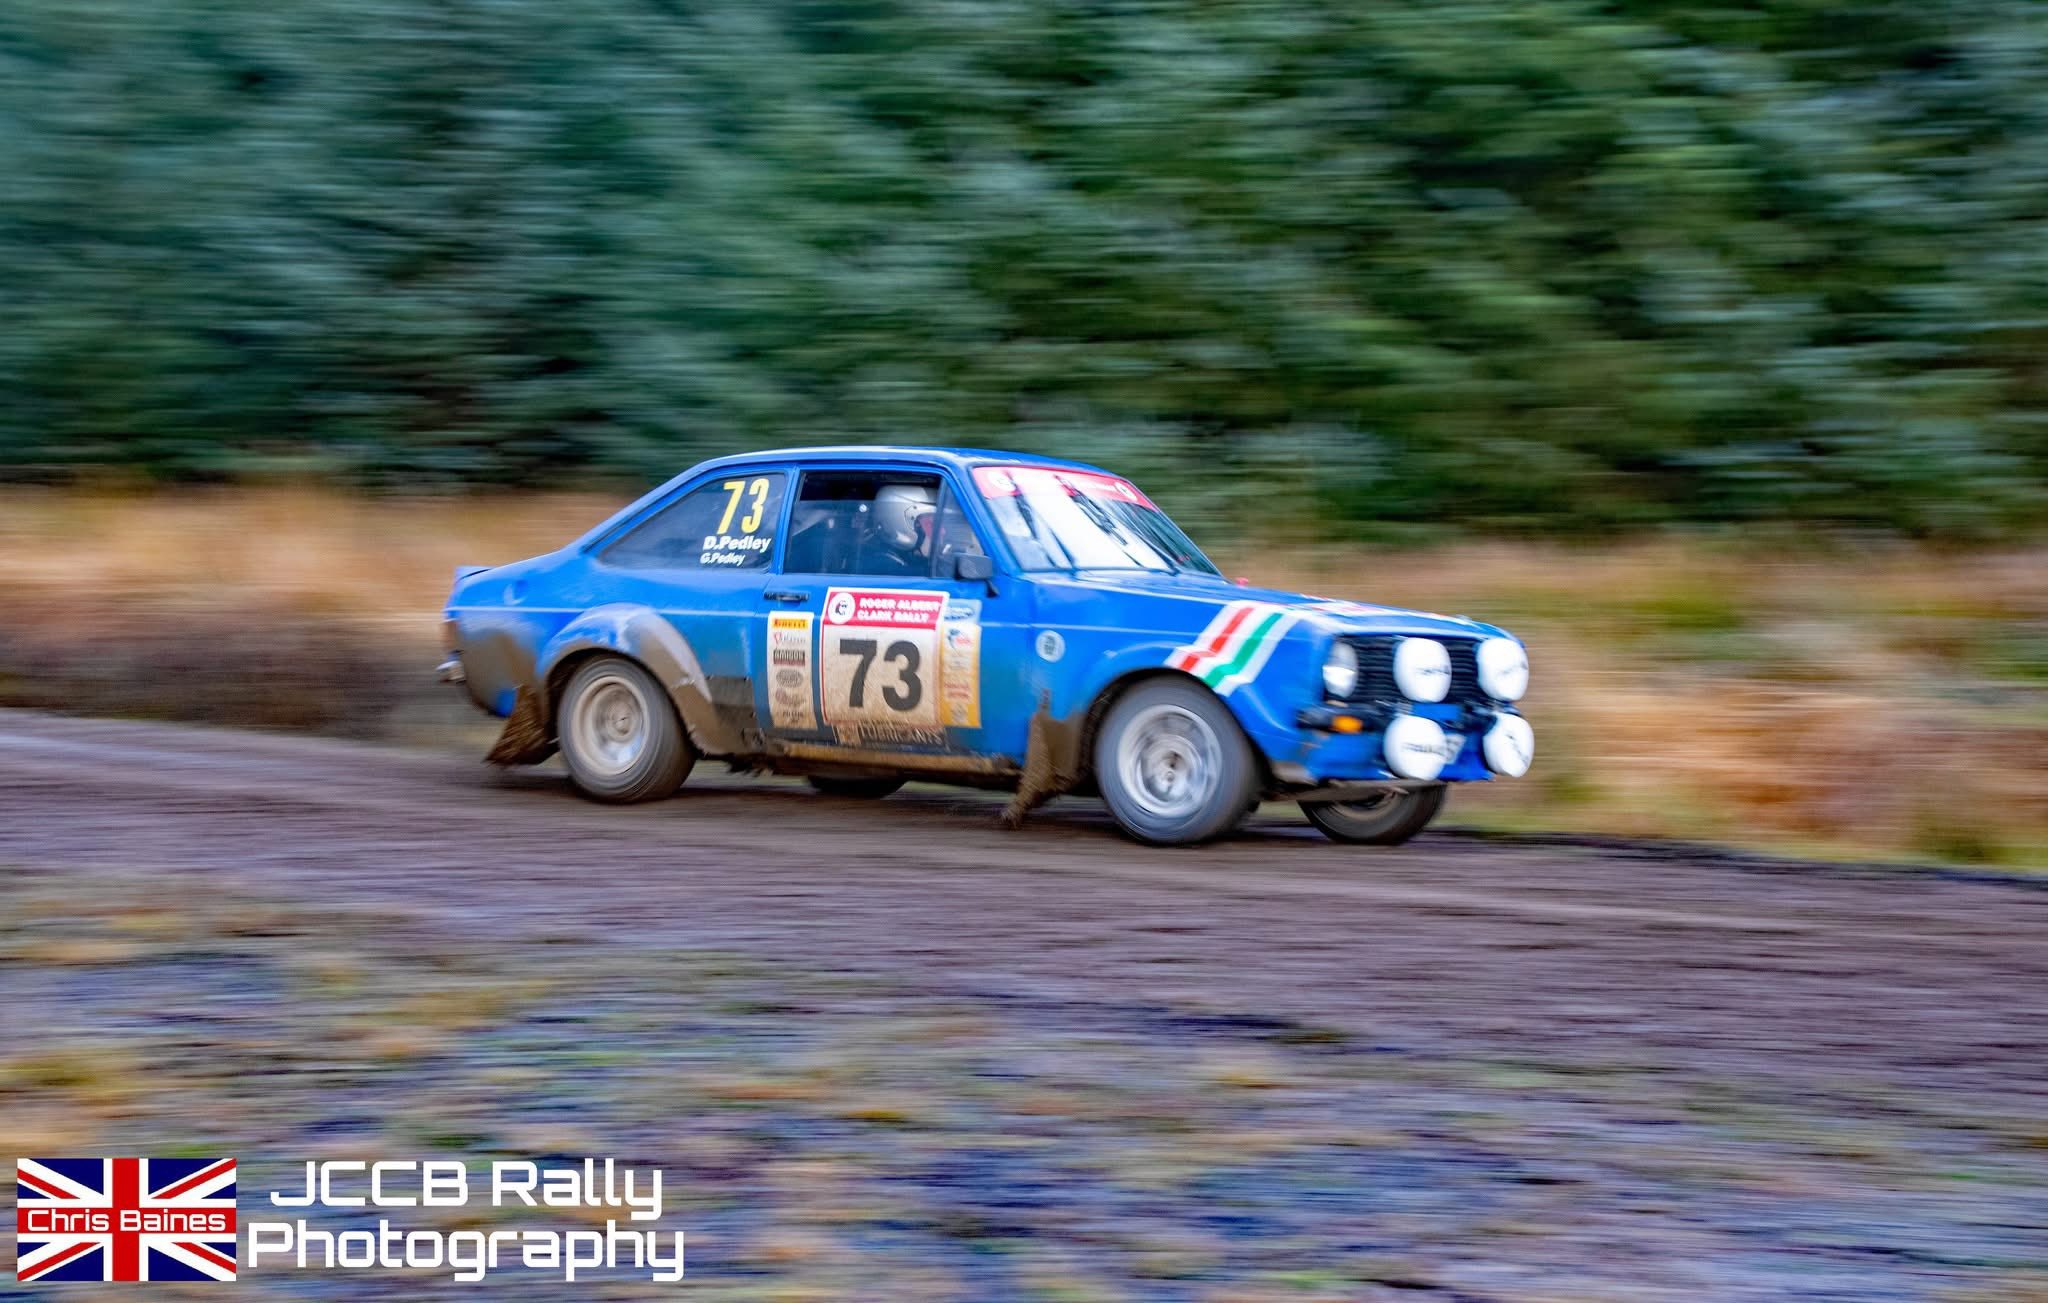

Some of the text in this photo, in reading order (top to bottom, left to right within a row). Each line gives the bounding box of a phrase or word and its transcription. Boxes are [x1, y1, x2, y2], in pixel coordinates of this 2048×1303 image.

[716, 478, 770, 535] 73
[702, 535, 772, 554] D.Pedley
[859, 597, 941, 612] ROGER ALBERT
[856, 609, 893, 622] CLARK
[893, 610, 930, 624] RALLY
[839, 638, 923, 712] 73
